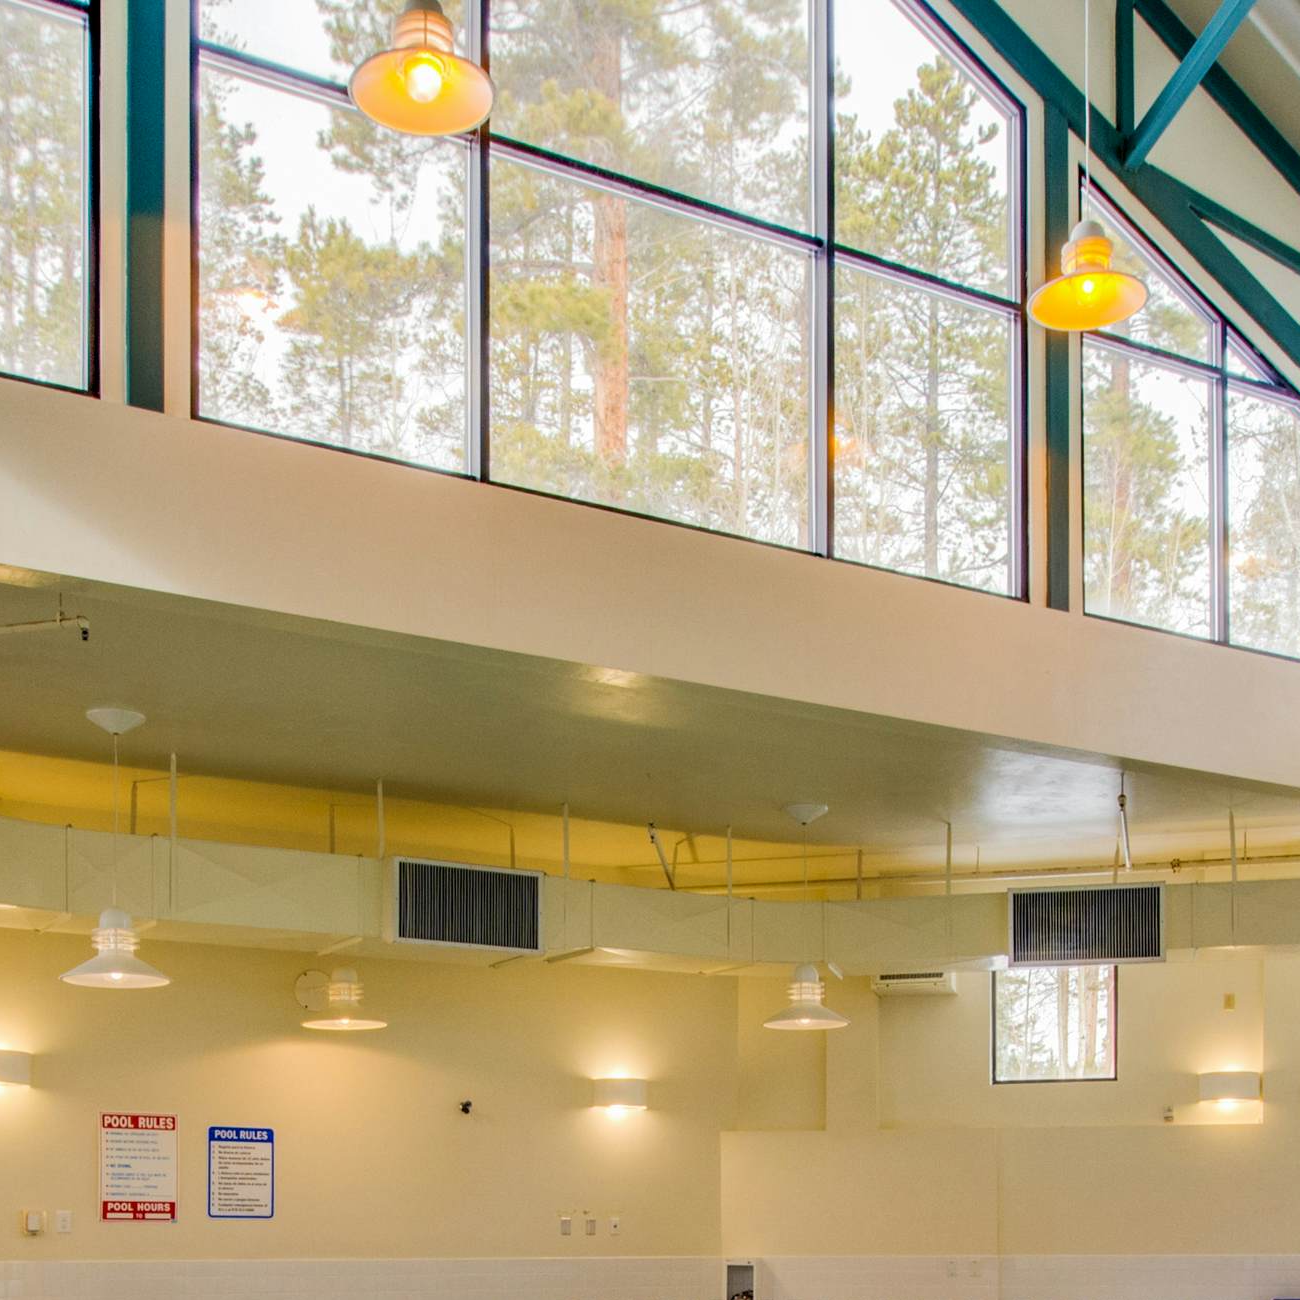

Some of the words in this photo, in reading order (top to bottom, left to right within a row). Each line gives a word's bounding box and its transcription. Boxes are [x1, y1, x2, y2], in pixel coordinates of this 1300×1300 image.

[104, 1116, 133, 1128] POOL
[138, 1117, 174, 1130] RULES
[214, 1129, 238, 1139] POOL
[240, 1130, 268, 1140] RULES
[107, 1202, 134, 1211] POOL
[137, 1202, 171, 1212] HOURS
